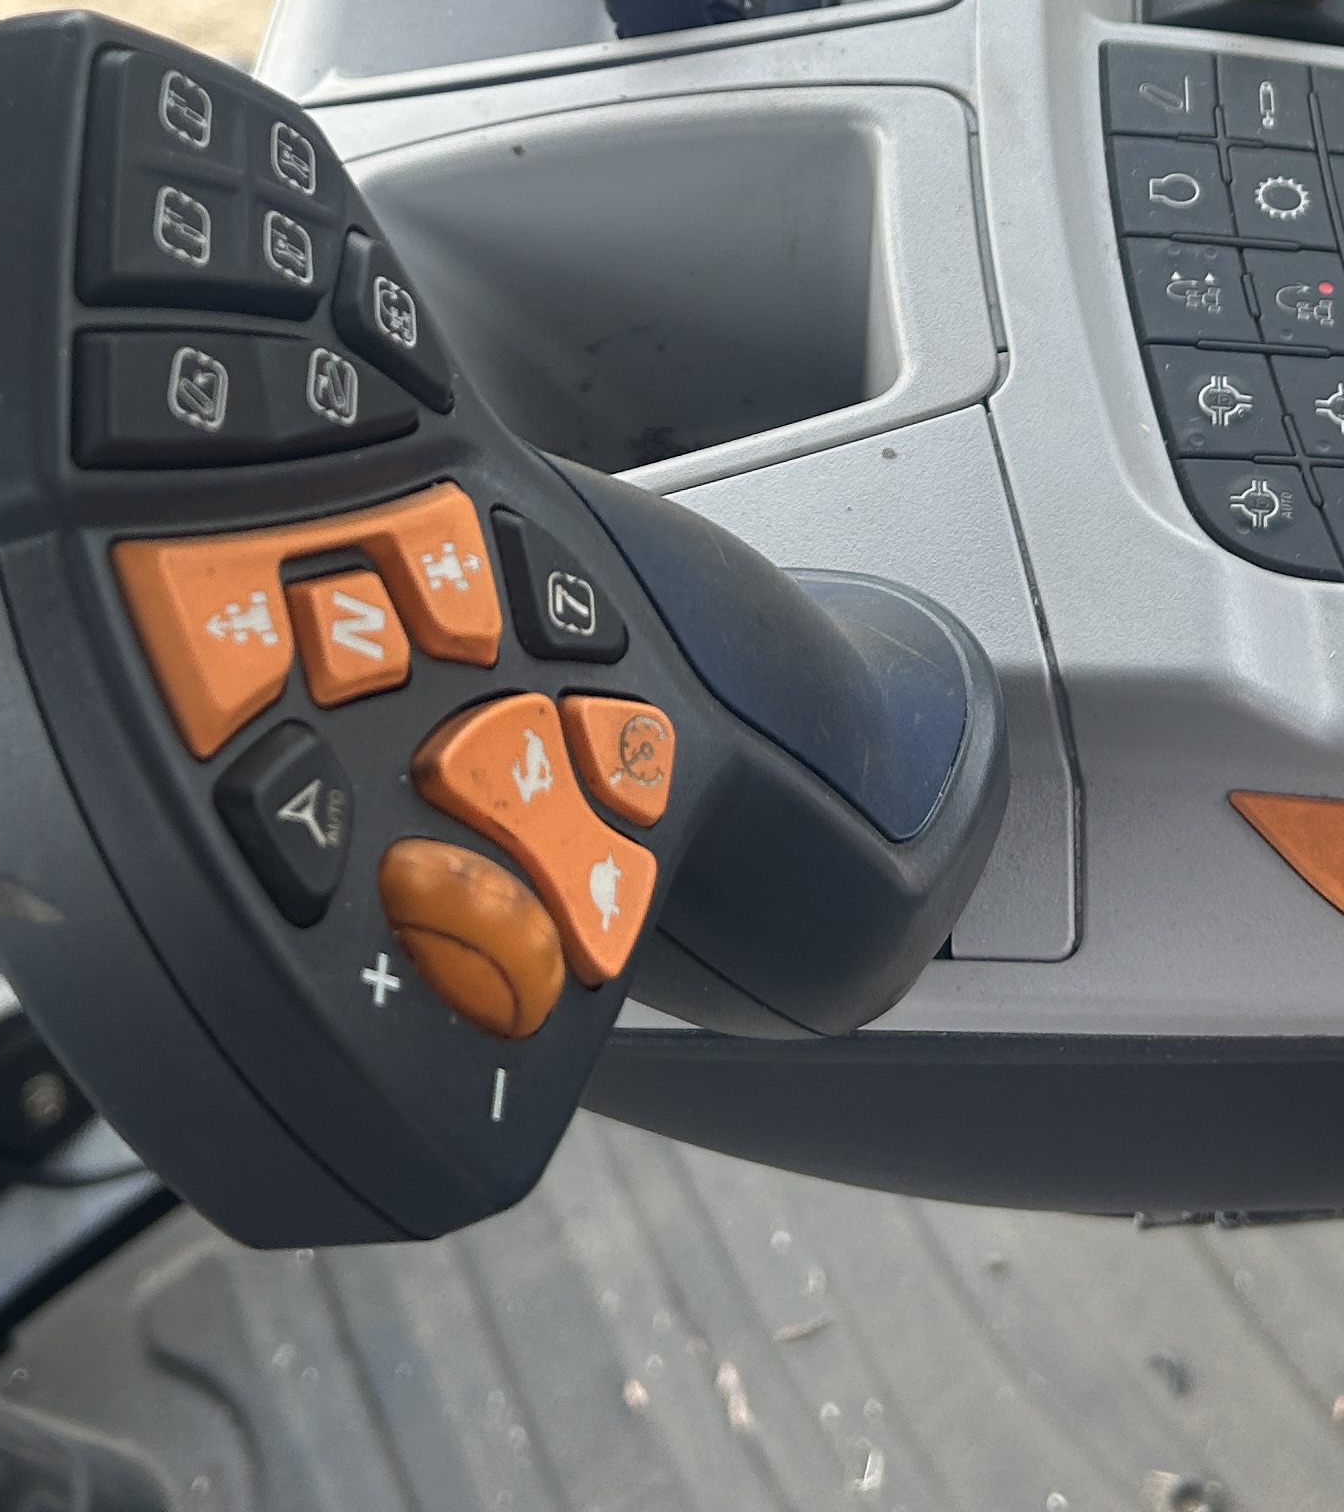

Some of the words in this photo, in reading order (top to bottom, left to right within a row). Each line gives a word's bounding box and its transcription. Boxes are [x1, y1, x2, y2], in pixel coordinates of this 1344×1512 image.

[1280, 491, 1293, 519] AUTO
[555, 584, 589, 618] 7
[332, 591, 386, 660] N
